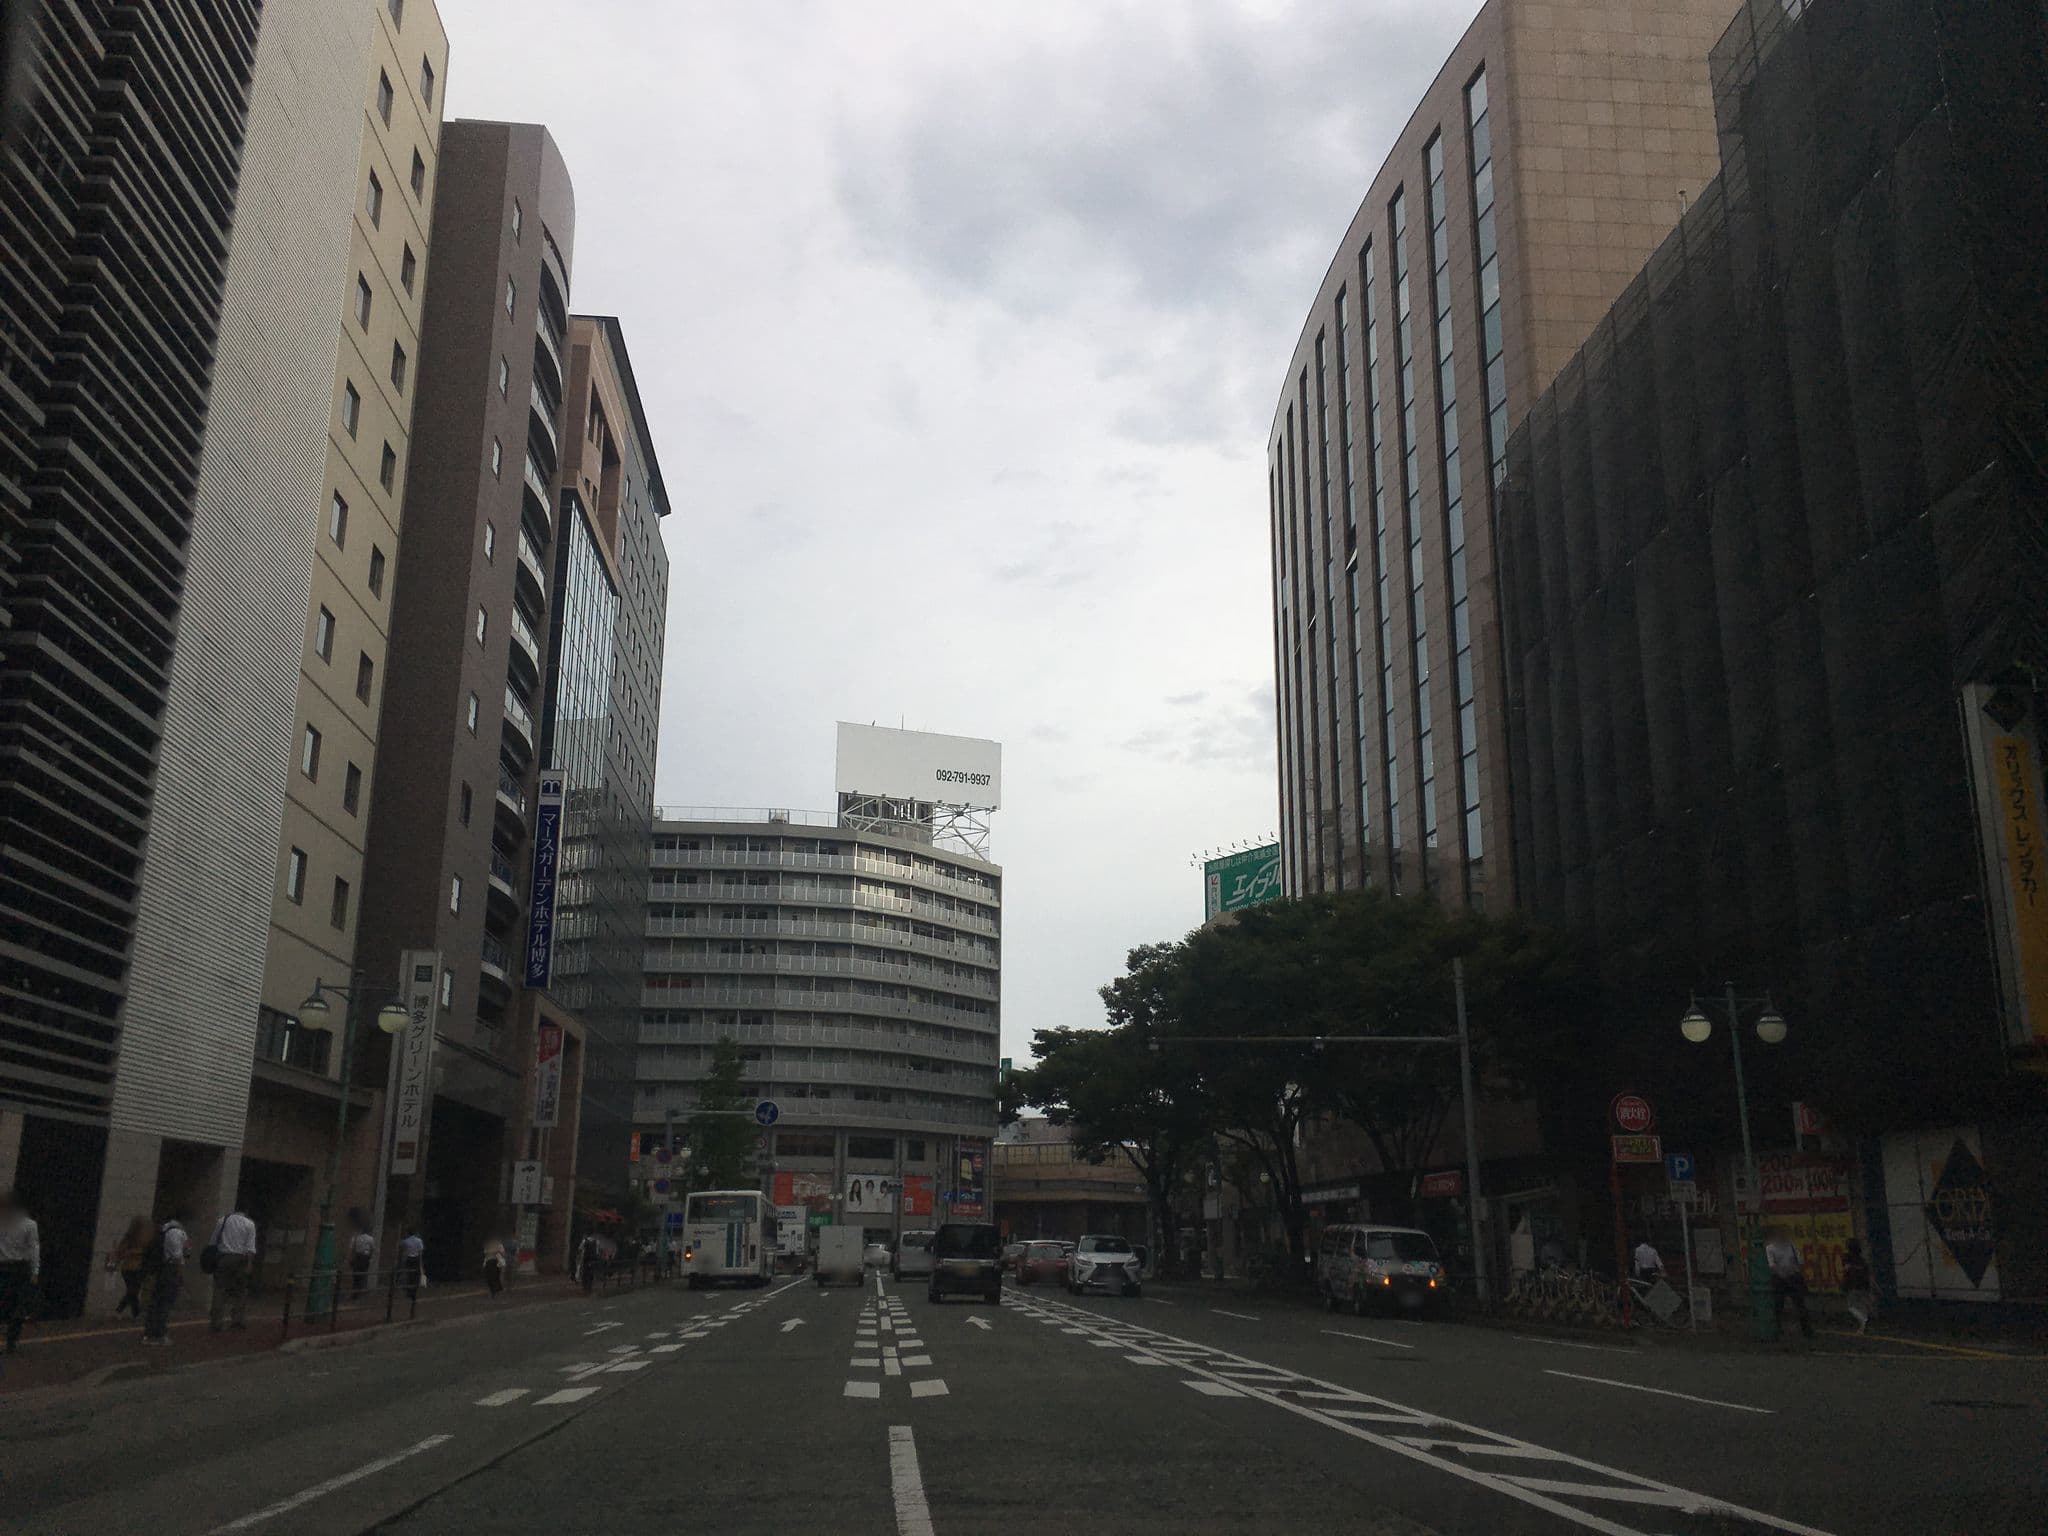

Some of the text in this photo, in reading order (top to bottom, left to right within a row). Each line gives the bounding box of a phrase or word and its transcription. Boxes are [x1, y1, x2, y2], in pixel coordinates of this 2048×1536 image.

[936, 769, 991, 786] 092-791-9937
[527, 811, 559, 979] マースガーデンホテル博多
[400, 994, 429, 1128] 博多グリーンホテル
[1618, 1106, 1648, 1121] 消火栓
[1674, 1157, 1689, 1178] P
